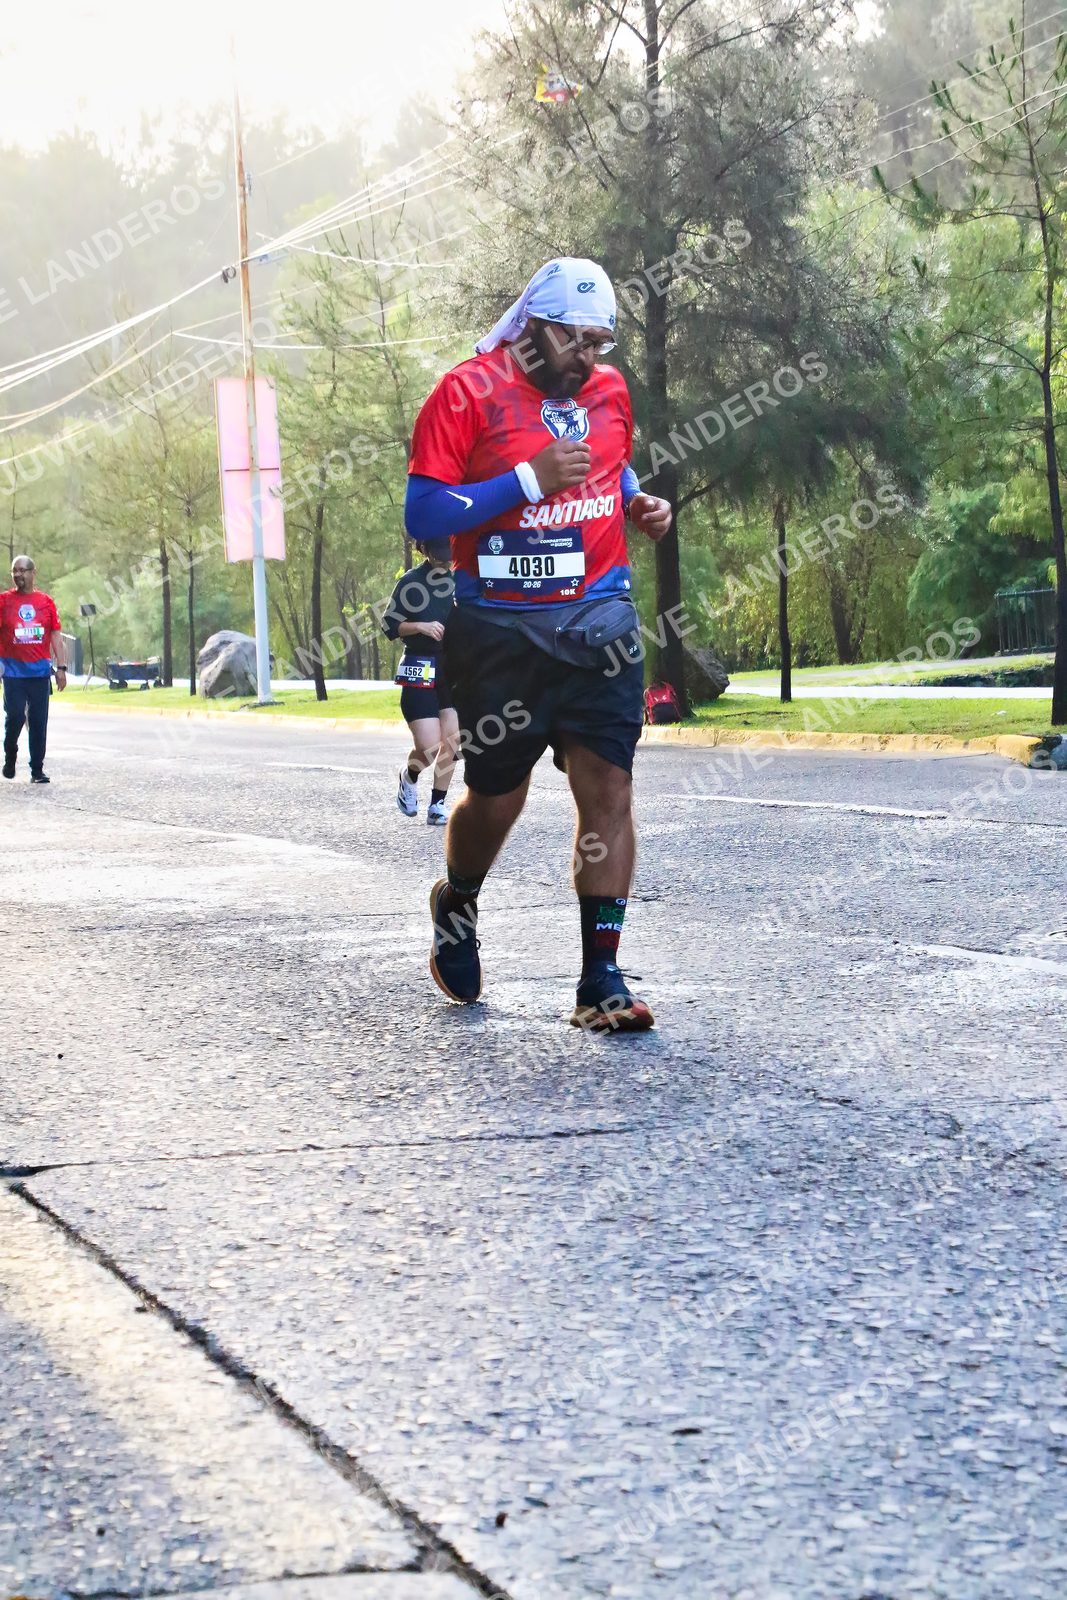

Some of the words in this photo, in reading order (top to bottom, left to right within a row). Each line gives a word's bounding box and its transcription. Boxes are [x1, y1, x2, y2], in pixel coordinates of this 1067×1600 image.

[519, 495, 615, 529] SANTIAGO
[508, 556, 555, 578] 4030
[560, 588, 576, 596] 10K
